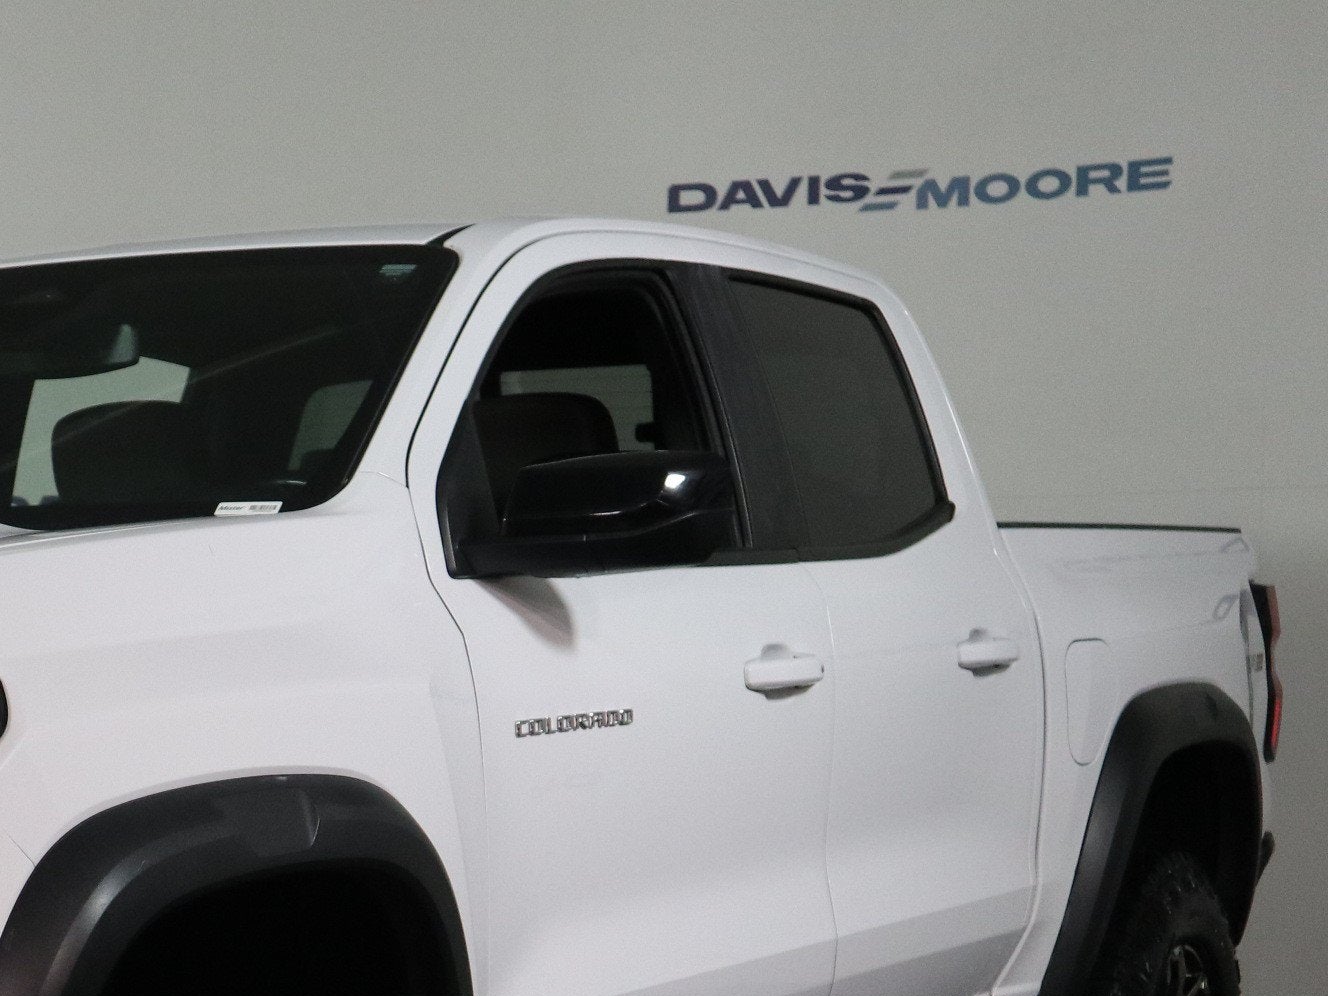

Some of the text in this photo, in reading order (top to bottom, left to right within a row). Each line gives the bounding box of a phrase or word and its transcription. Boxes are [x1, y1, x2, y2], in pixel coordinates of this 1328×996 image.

[667, 156, 1173, 213] DAVIS MOORE
[514, 709, 633, 738] COLORADO
